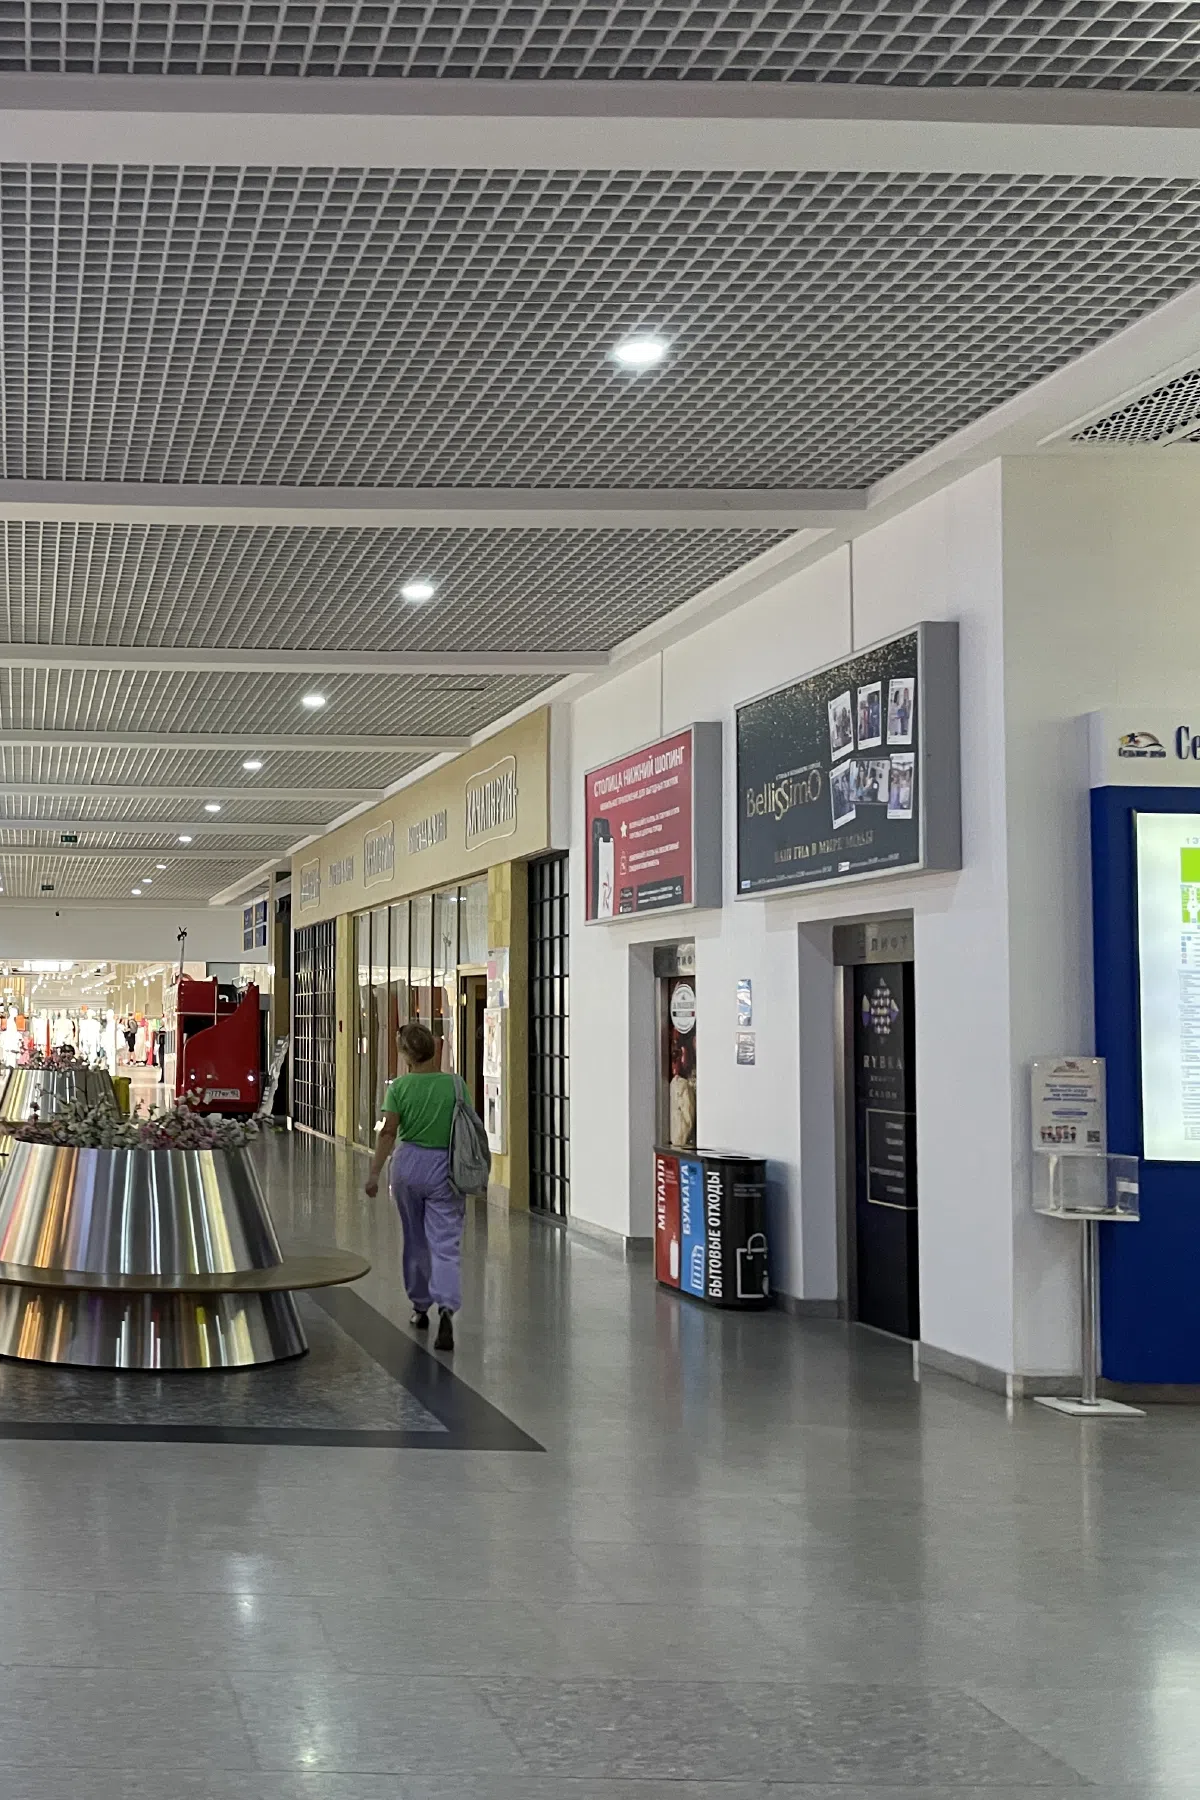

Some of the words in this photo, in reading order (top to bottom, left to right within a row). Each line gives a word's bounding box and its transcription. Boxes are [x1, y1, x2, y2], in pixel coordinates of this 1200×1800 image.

[594, 772, 623, 798] СТОЛИЦА
[623, 754, 653, 787] НИЖНИЙ
[654, 745, 685, 775] ШОПИНГ
[863, 1054, 903, 1070] RYBKA
[657, 1158, 666, 1231] МЕТАЛЛ
[680, 1164, 692, 1235] БУМАГА
[706, 1171, 724, 1227] ОТХОДЫ
[708, 1228, 723, 1298] БЫТОВЫЕ
